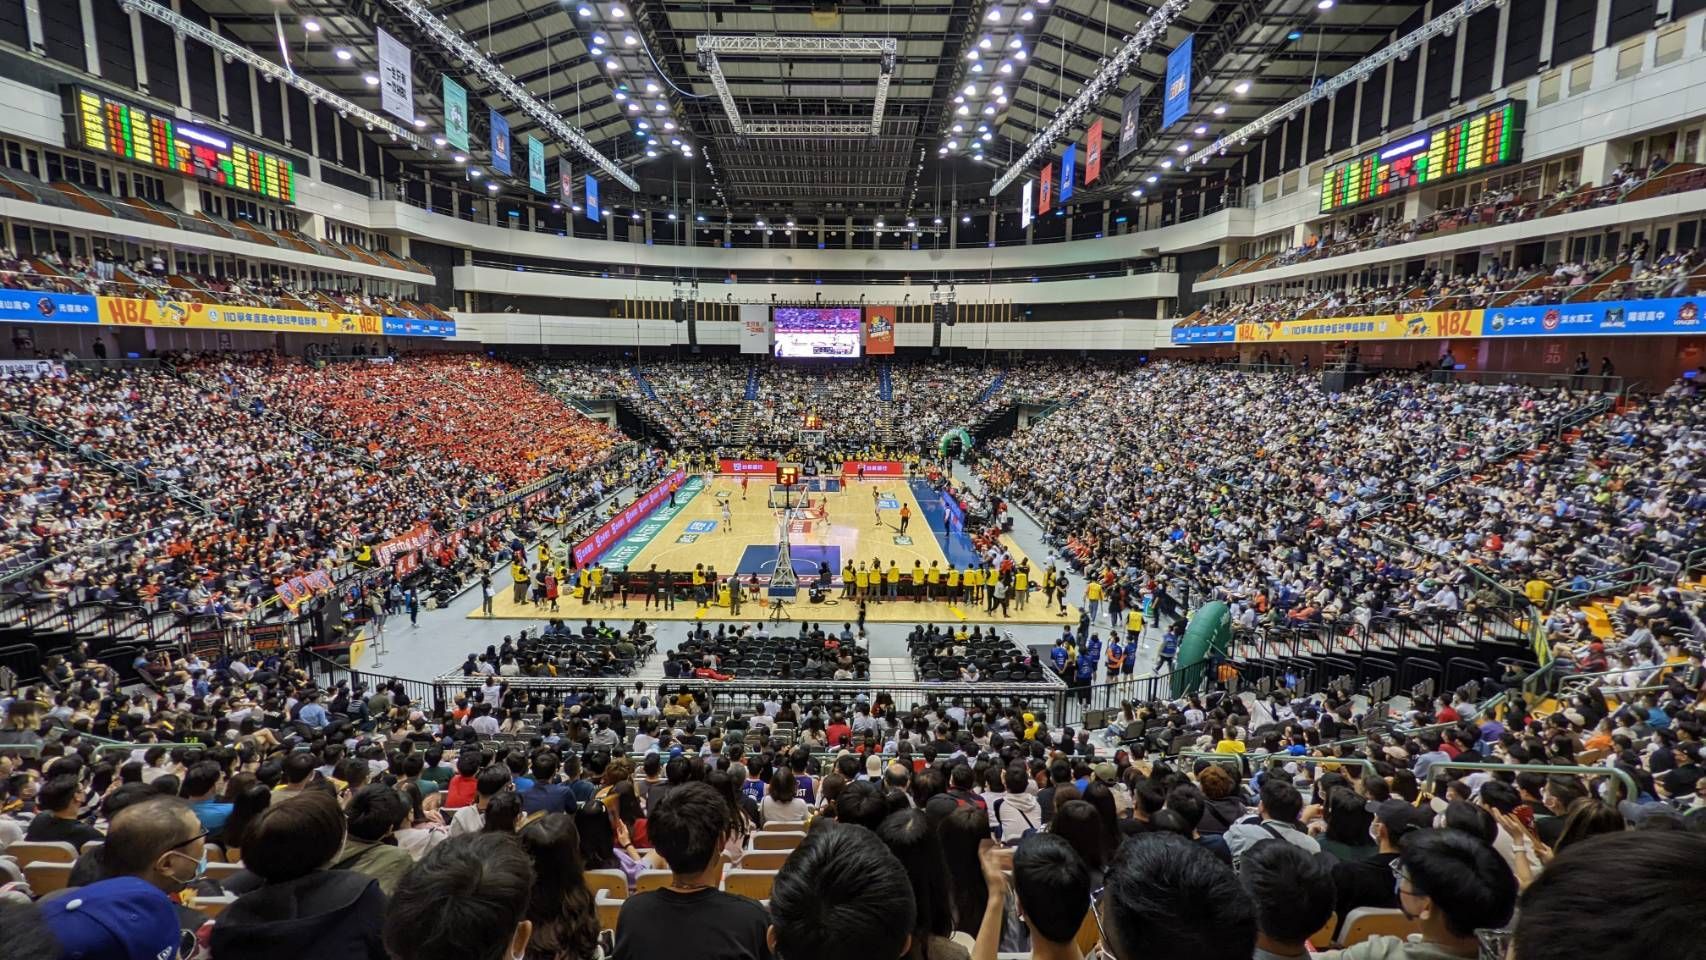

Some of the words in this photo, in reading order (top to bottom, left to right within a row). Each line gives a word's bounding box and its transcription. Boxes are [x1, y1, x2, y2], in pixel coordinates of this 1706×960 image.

[108, 298, 152, 325] HBL
[359, 317, 378, 333] HBL
[1437, 310, 1473, 337] HBL
[1239, 325, 1255, 340] HBL
[780, 474, 794, 484] 21
